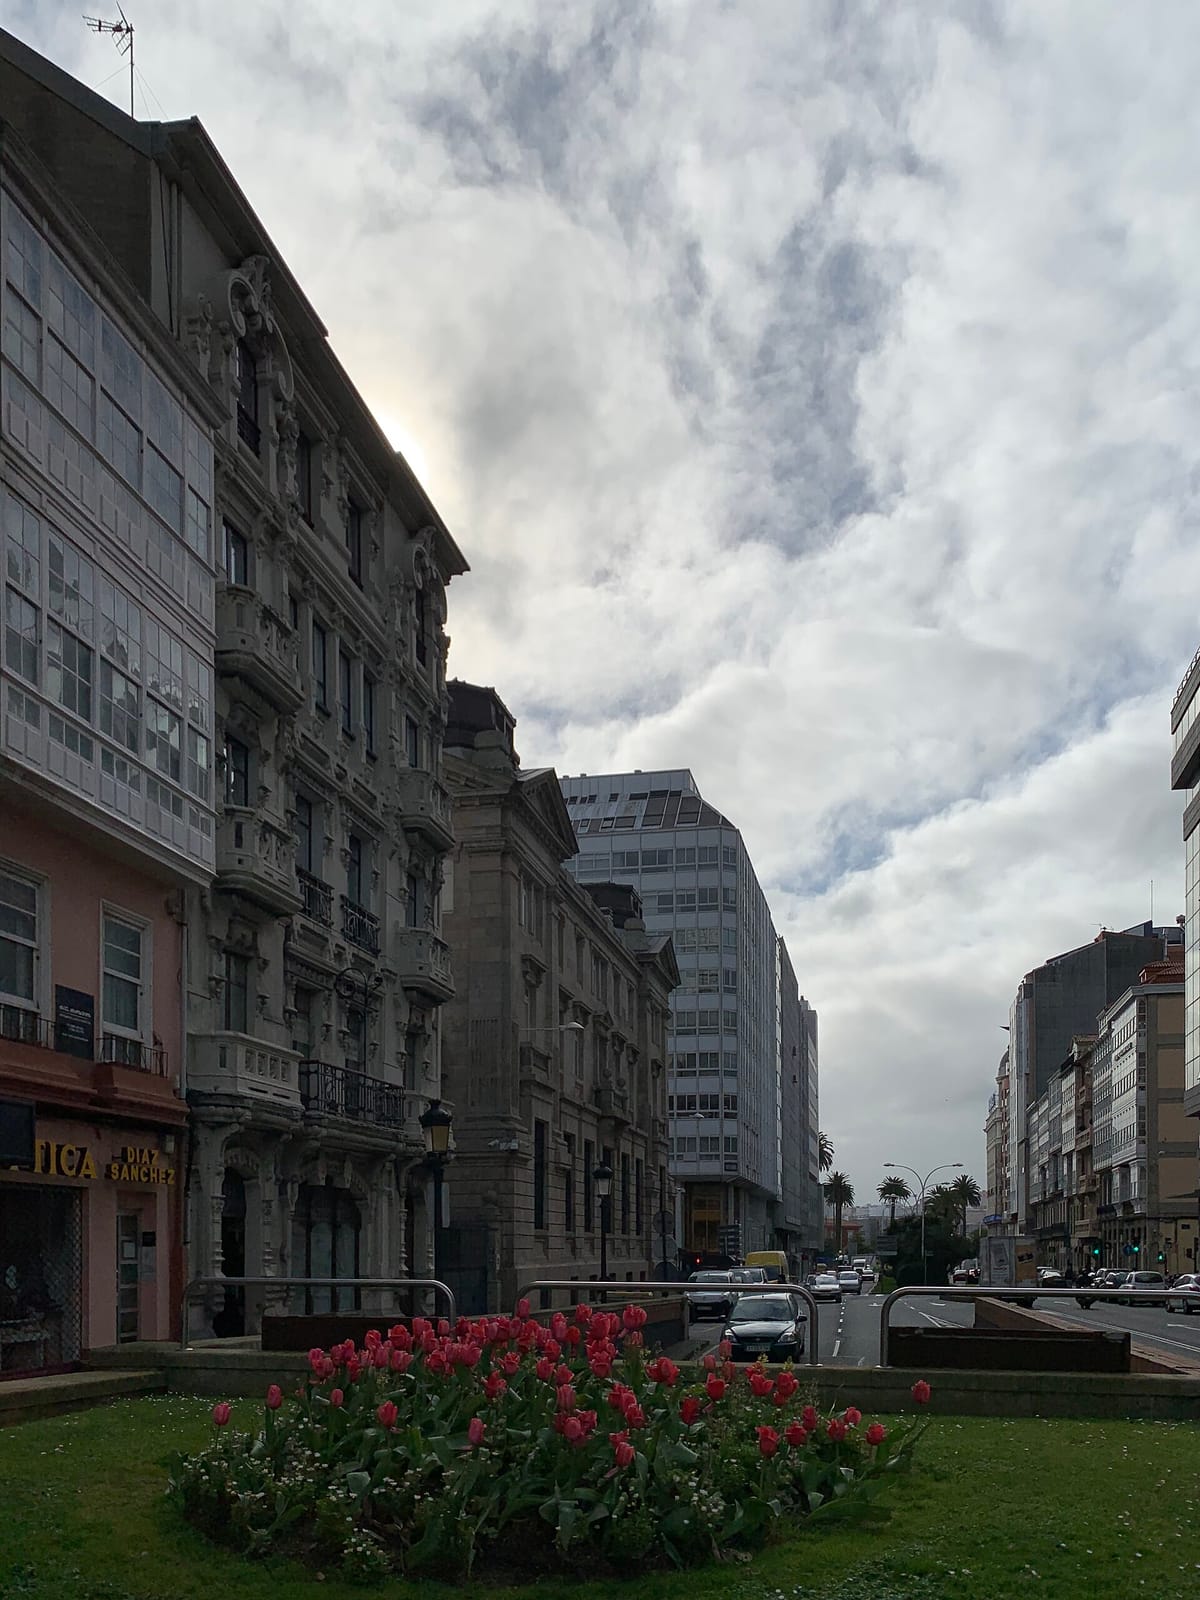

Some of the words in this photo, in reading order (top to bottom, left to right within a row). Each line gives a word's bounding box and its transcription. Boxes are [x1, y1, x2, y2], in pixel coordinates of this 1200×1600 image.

[32, 1139, 97, 1179] TICA
[127, 1146, 160, 1166] DIAZ
[111, 1161, 176, 1185] SANCHEZ
